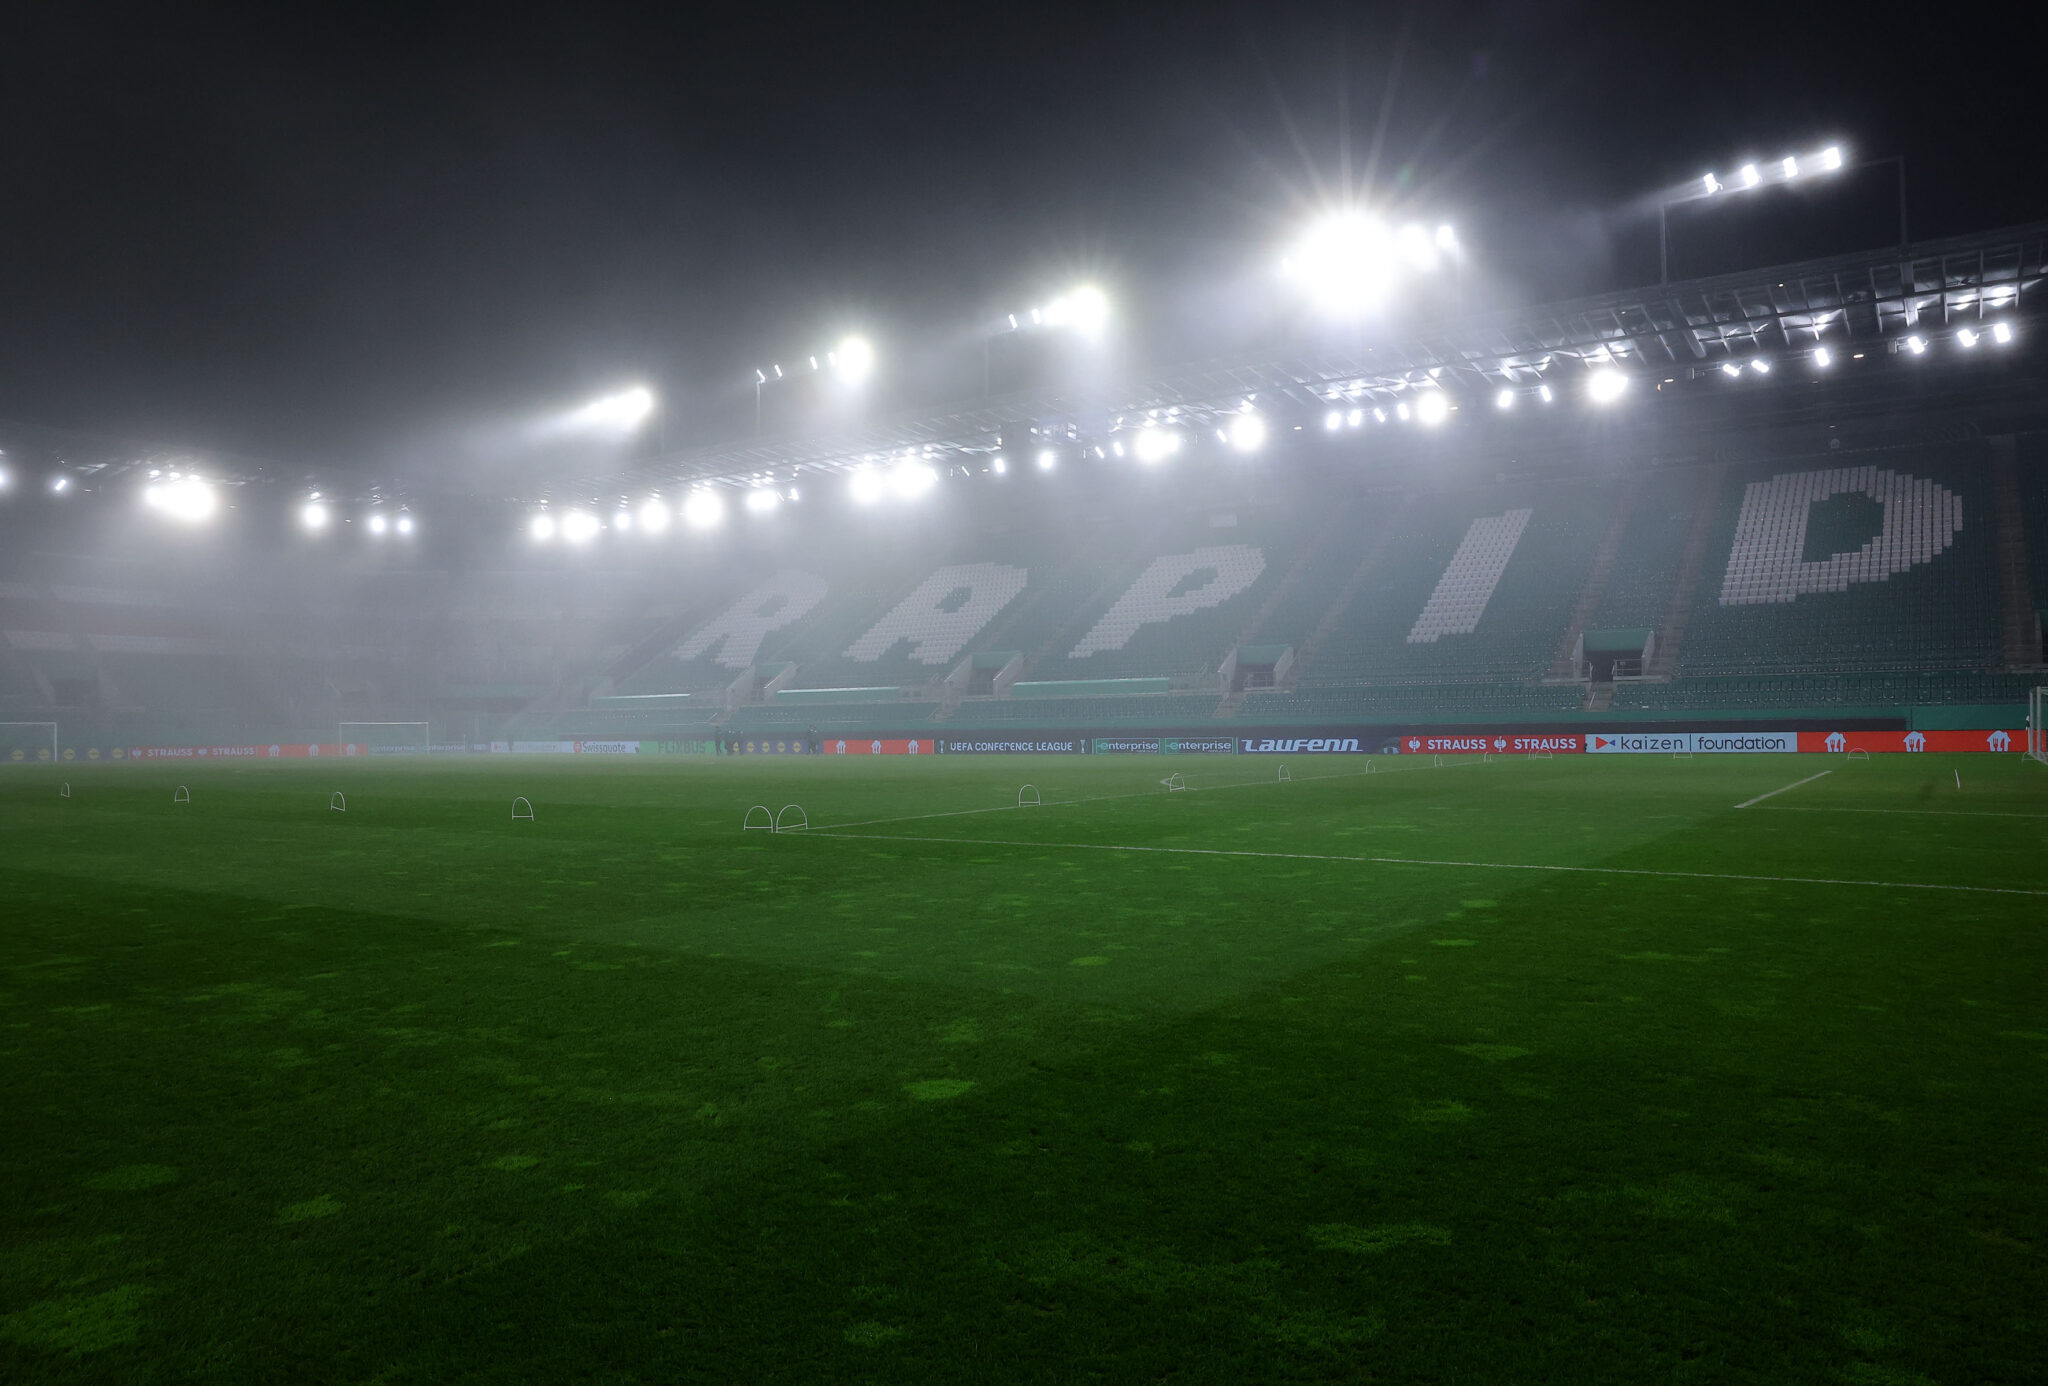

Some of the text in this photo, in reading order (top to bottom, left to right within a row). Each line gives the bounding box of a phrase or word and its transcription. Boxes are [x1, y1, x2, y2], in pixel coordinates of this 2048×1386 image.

[582, 742, 626, 754] Swissquote
[950, 742, 1072, 751] UEFA CONFERENCE LEAGUE
[1100, 741, 1158, 752] enterprise
[1170, 741, 1232, 752] enterprise
[1427, 739, 1487, 750] STRAUSS
[1514, 738, 1577, 750] STRAUSS
[1621, 736, 1786, 750] kaizen foundation
[147, 748, 193, 757] STRAUSS
[212, 747, 255, 756] STRAUSS
